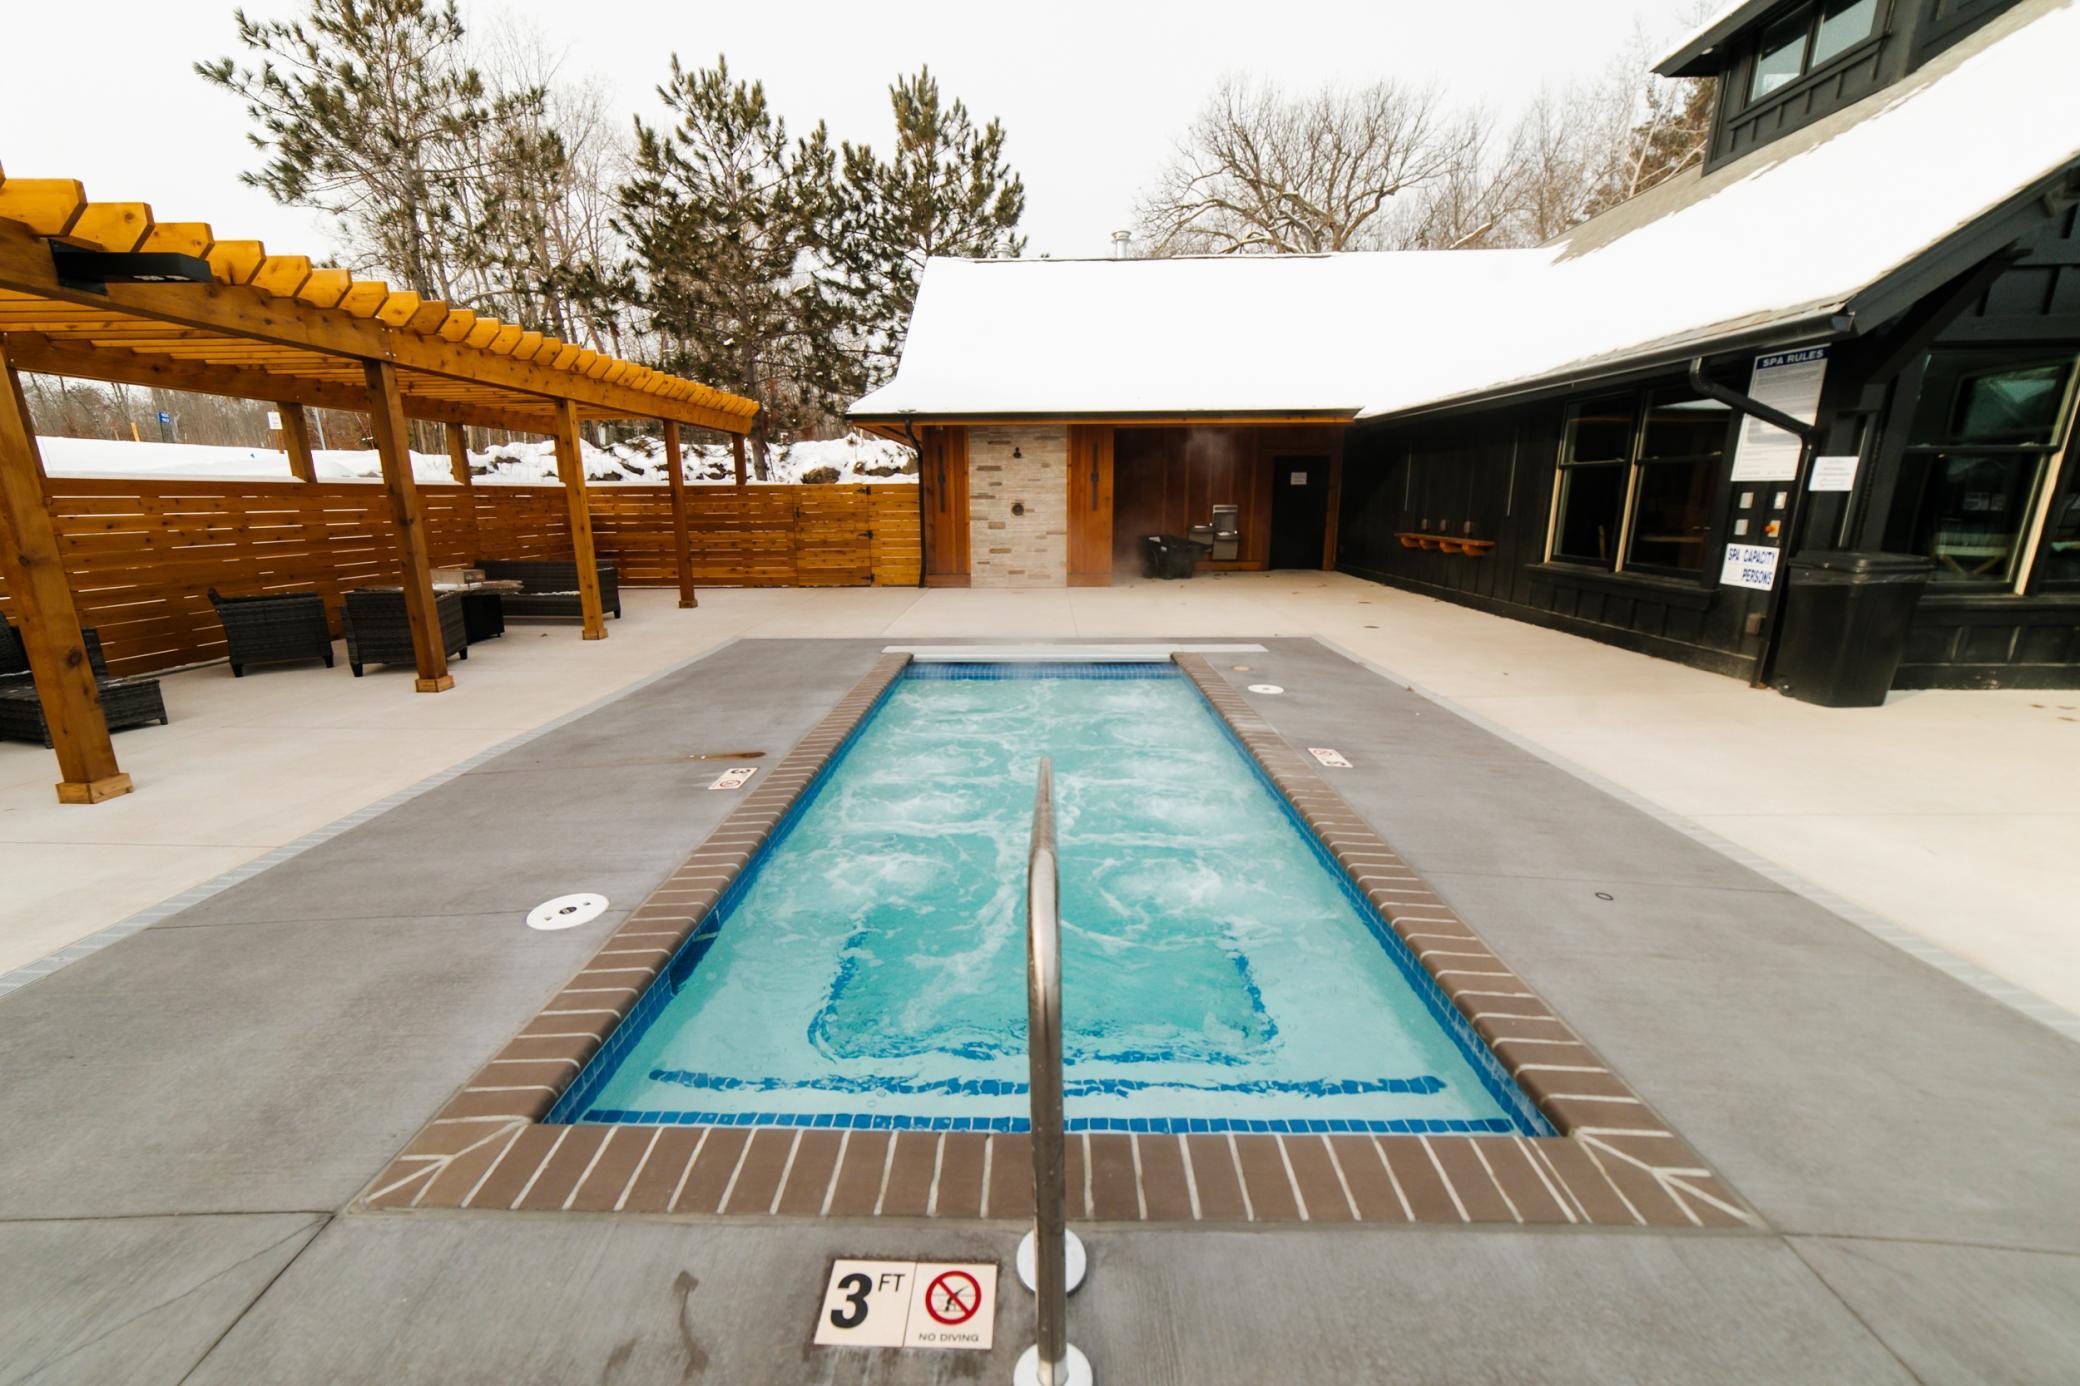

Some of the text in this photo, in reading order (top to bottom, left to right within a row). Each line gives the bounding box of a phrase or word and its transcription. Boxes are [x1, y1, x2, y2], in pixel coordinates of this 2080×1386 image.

[1763, 349, 1824, 367] SPA RULES
[1728, 548, 1775, 566] SPA CAPACITY
[1742, 568, 1773, 585] PERSONS
[830, 1273, 905, 1329] 3 FT
[918, 1333, 979, 1342] NO DIVING
